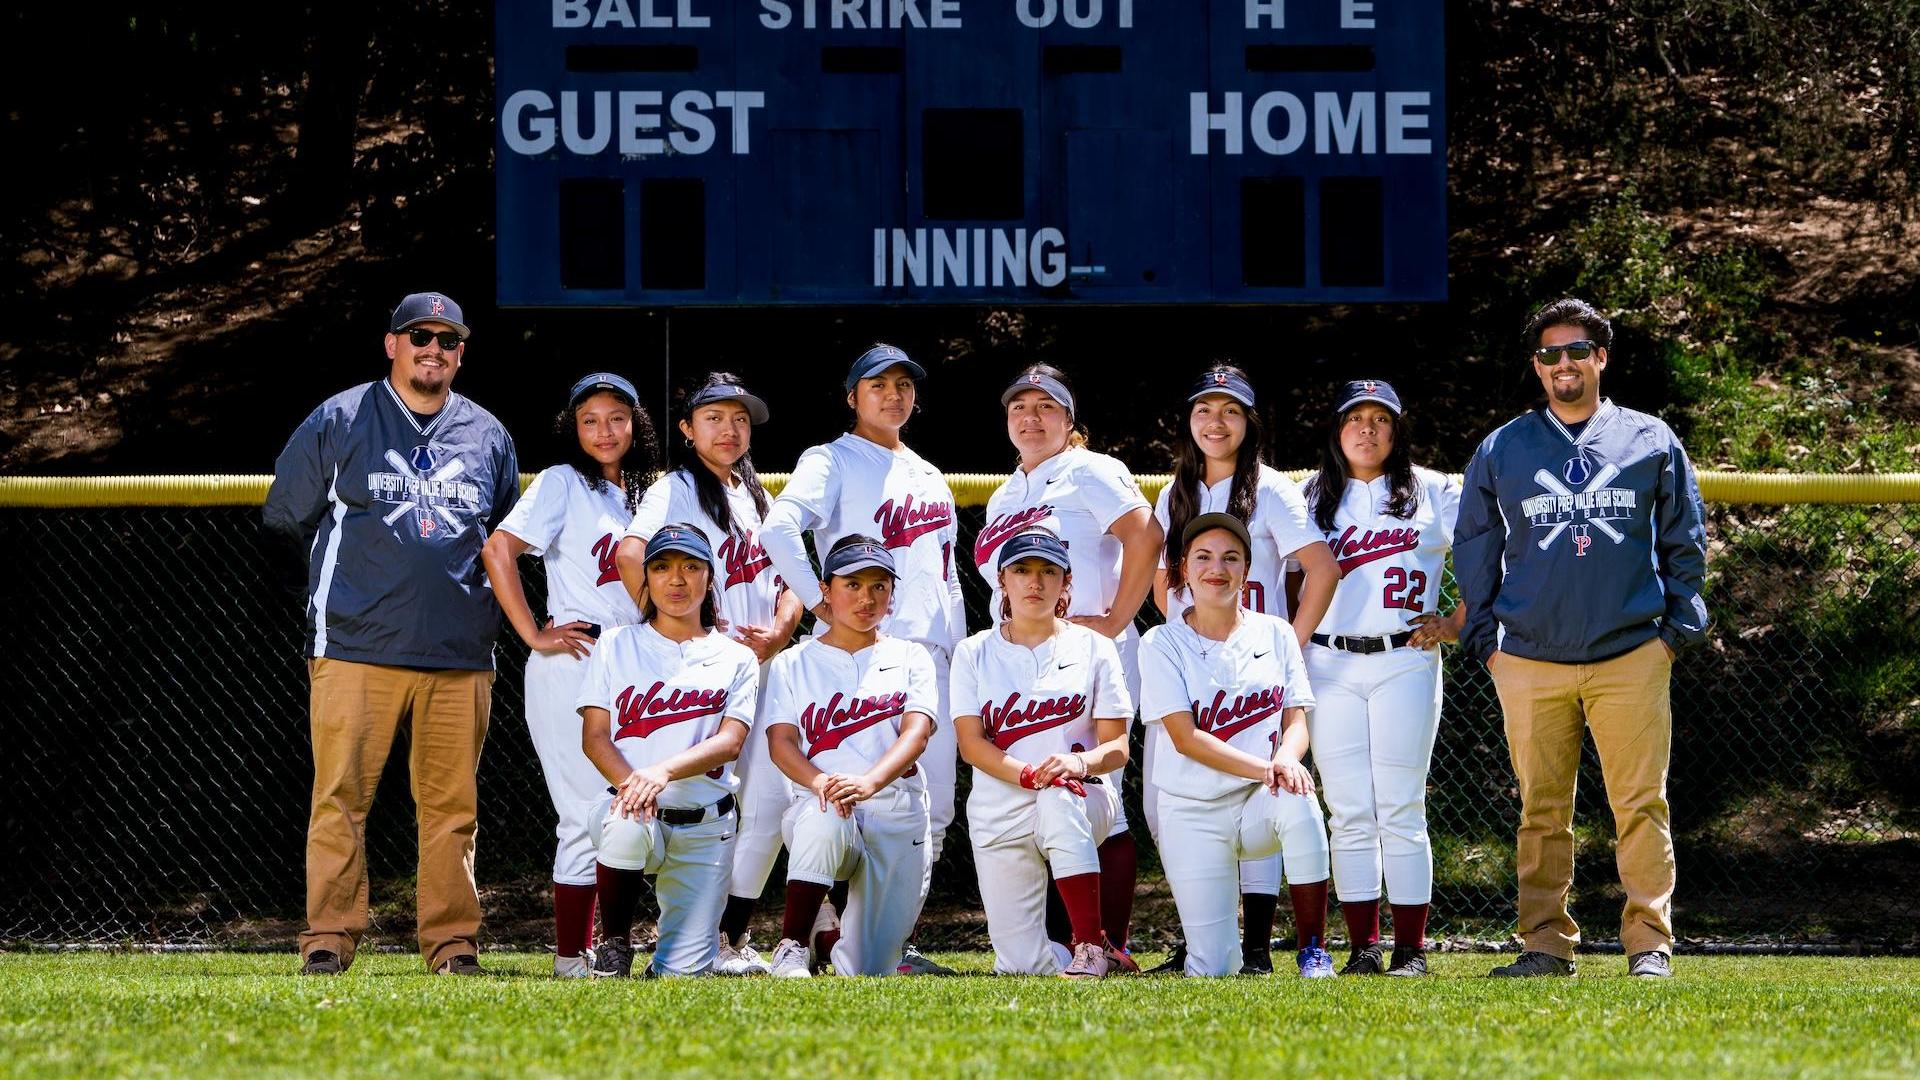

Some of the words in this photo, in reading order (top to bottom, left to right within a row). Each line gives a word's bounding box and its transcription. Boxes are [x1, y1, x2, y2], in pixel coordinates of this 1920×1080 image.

[552, 0, 711, 28] BALL
[759, 0, 962, 29] STRIKE
[1016, 0, 1133, 29] OUT
[1245, 0, 1285, 29] H
[1341, 0, 1375, 29] E
[502, 90, 765, 155] GUEST
[1189, 91, 1432, 155] HOME
[873, 227, 1066, 287] INNING
[368, 473, 404, 492] UNIVERSITY
[404, 477, 420, 495] PREP
[420, 480, 441, 497] VALUE
[441, 481, 456, 498] HIGH
[457, 483, 480, 503] SCHOOL
[373, 489, 473, 508] SOFTBAL
[1521, 496, 1558, 517] UNIVERSITY
[1558, 495, 1574, 513] PREP
[1574, 492, 1595, 510] VALUE
[1595, 491, 1612, 508] HIGH
[1612, 490, 1637, 508] SCHOOL
[415, 508, 436, 538] UP
[1531, 507, 1631, 525] SOFTBALL
[1569, 524, 1592, 556] UP
[1384, 567, 1427, 613] 22
[615, 681, 728, 728] Wolves
[801, 691, 908, 745] Wolves
[981, 692, 1087, 741] Wolves
[1191, 685, 1284, 734] Wolves
